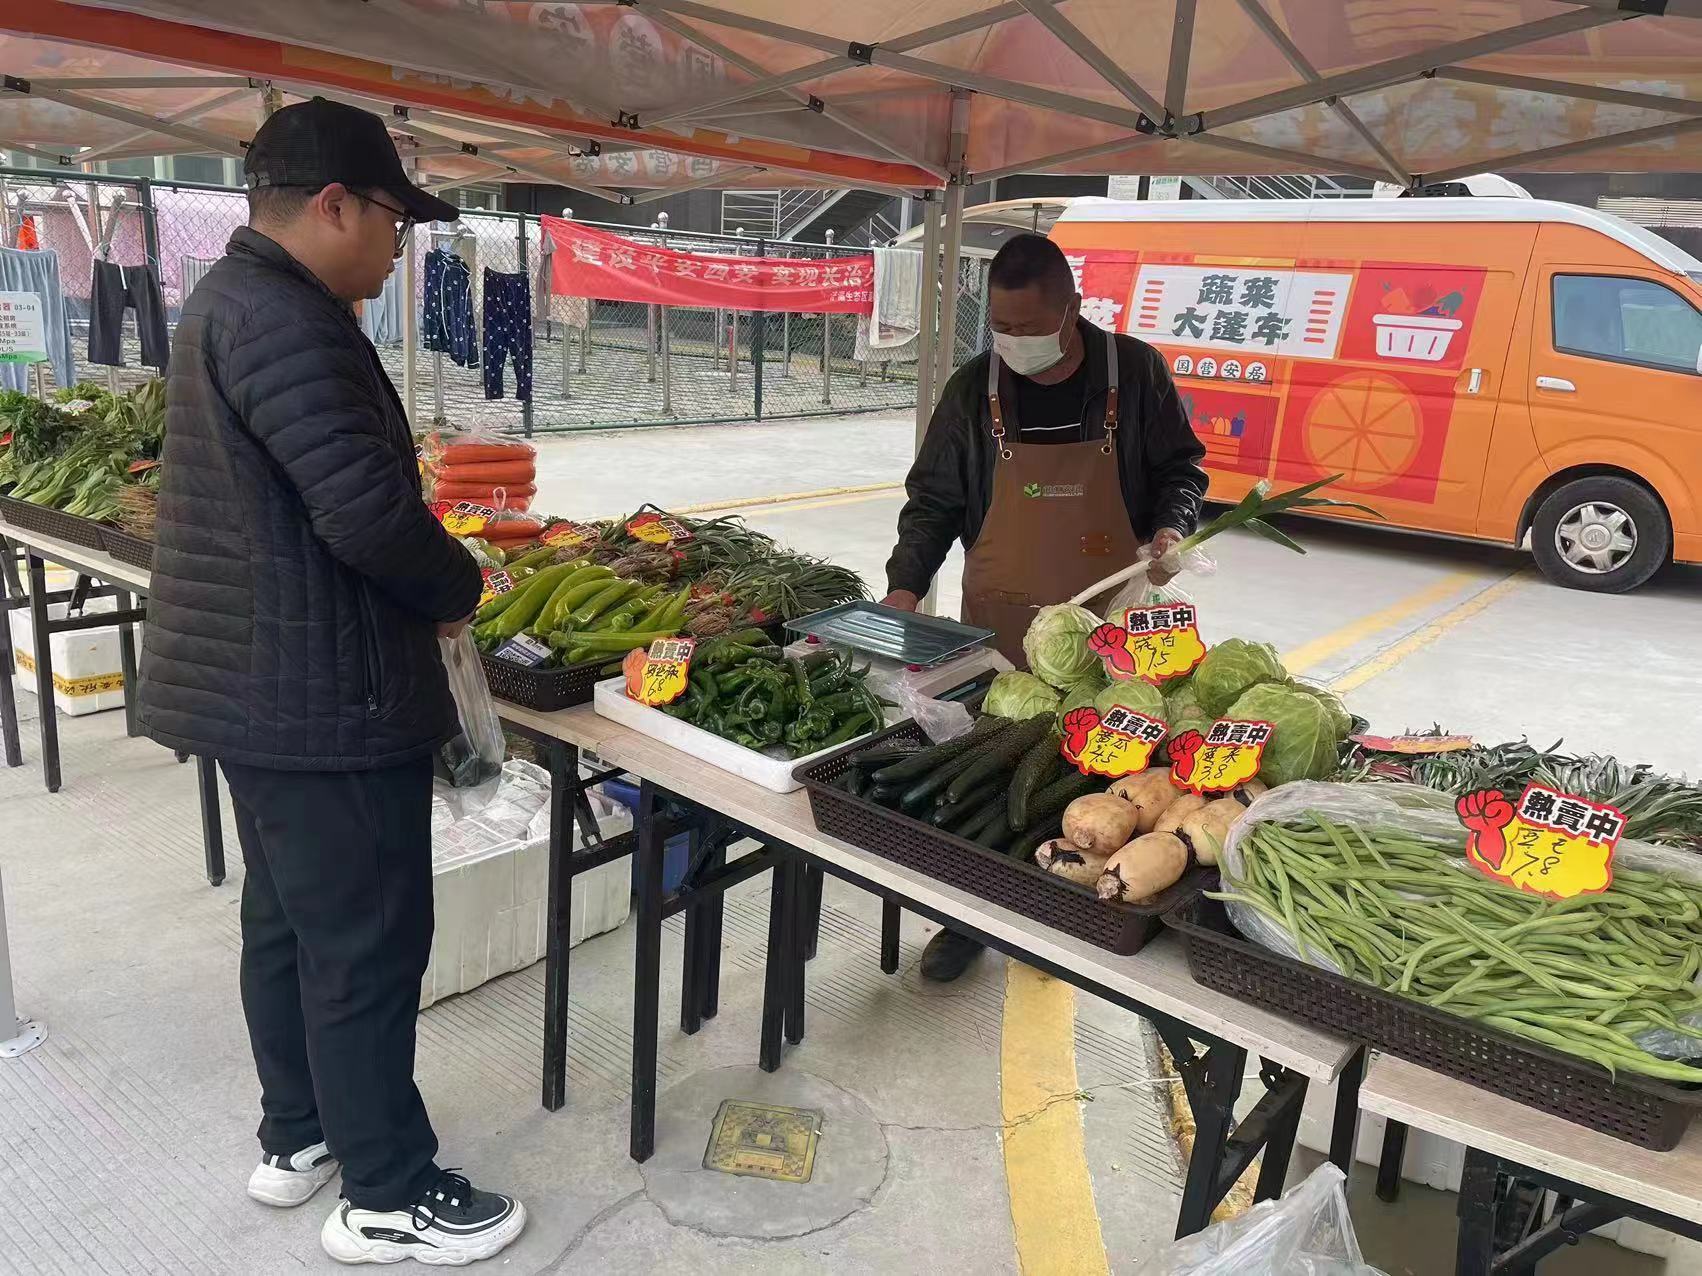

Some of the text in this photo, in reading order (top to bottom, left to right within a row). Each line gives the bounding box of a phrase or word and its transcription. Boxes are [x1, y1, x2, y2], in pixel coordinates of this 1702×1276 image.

[571, 239, 760, 283] 建设平安西安
[1196, 274, 1279, 309] 蔬菜
[1171, 307, 1293, 346] 大篷车
[1177, 358, 1265, 381] 国营安居
[1130, 607, 1192, 631] 熱賣中
[1104, 709, 1166, 741] 熱賣中
[1208, 722, 1271, 744] 熱賣中
[1198, 764, 1228, 782] 3.8
[1523, 790, 1620, 841] 熱賣中
[1511, 851, 1560, 876] 7.8
